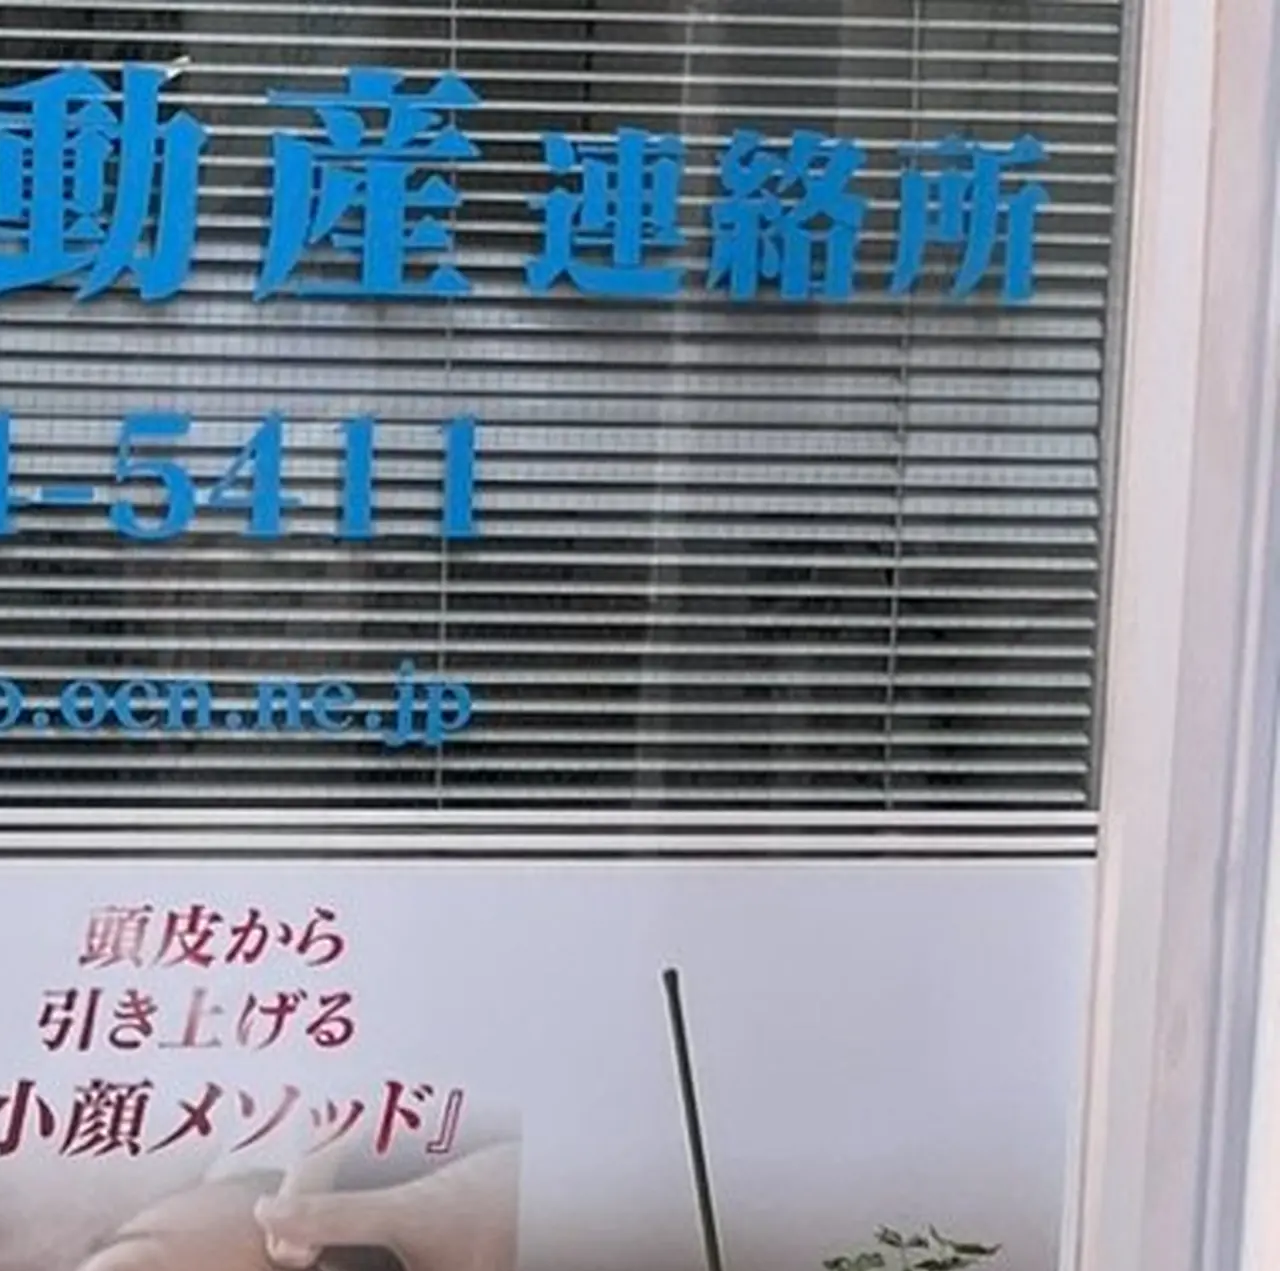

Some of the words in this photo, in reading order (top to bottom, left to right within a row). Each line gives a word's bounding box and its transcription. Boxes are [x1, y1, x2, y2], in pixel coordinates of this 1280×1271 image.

[78, 903, 343, 969] 頭皮から
[37, 987, 356, 1052] 引き上げる
